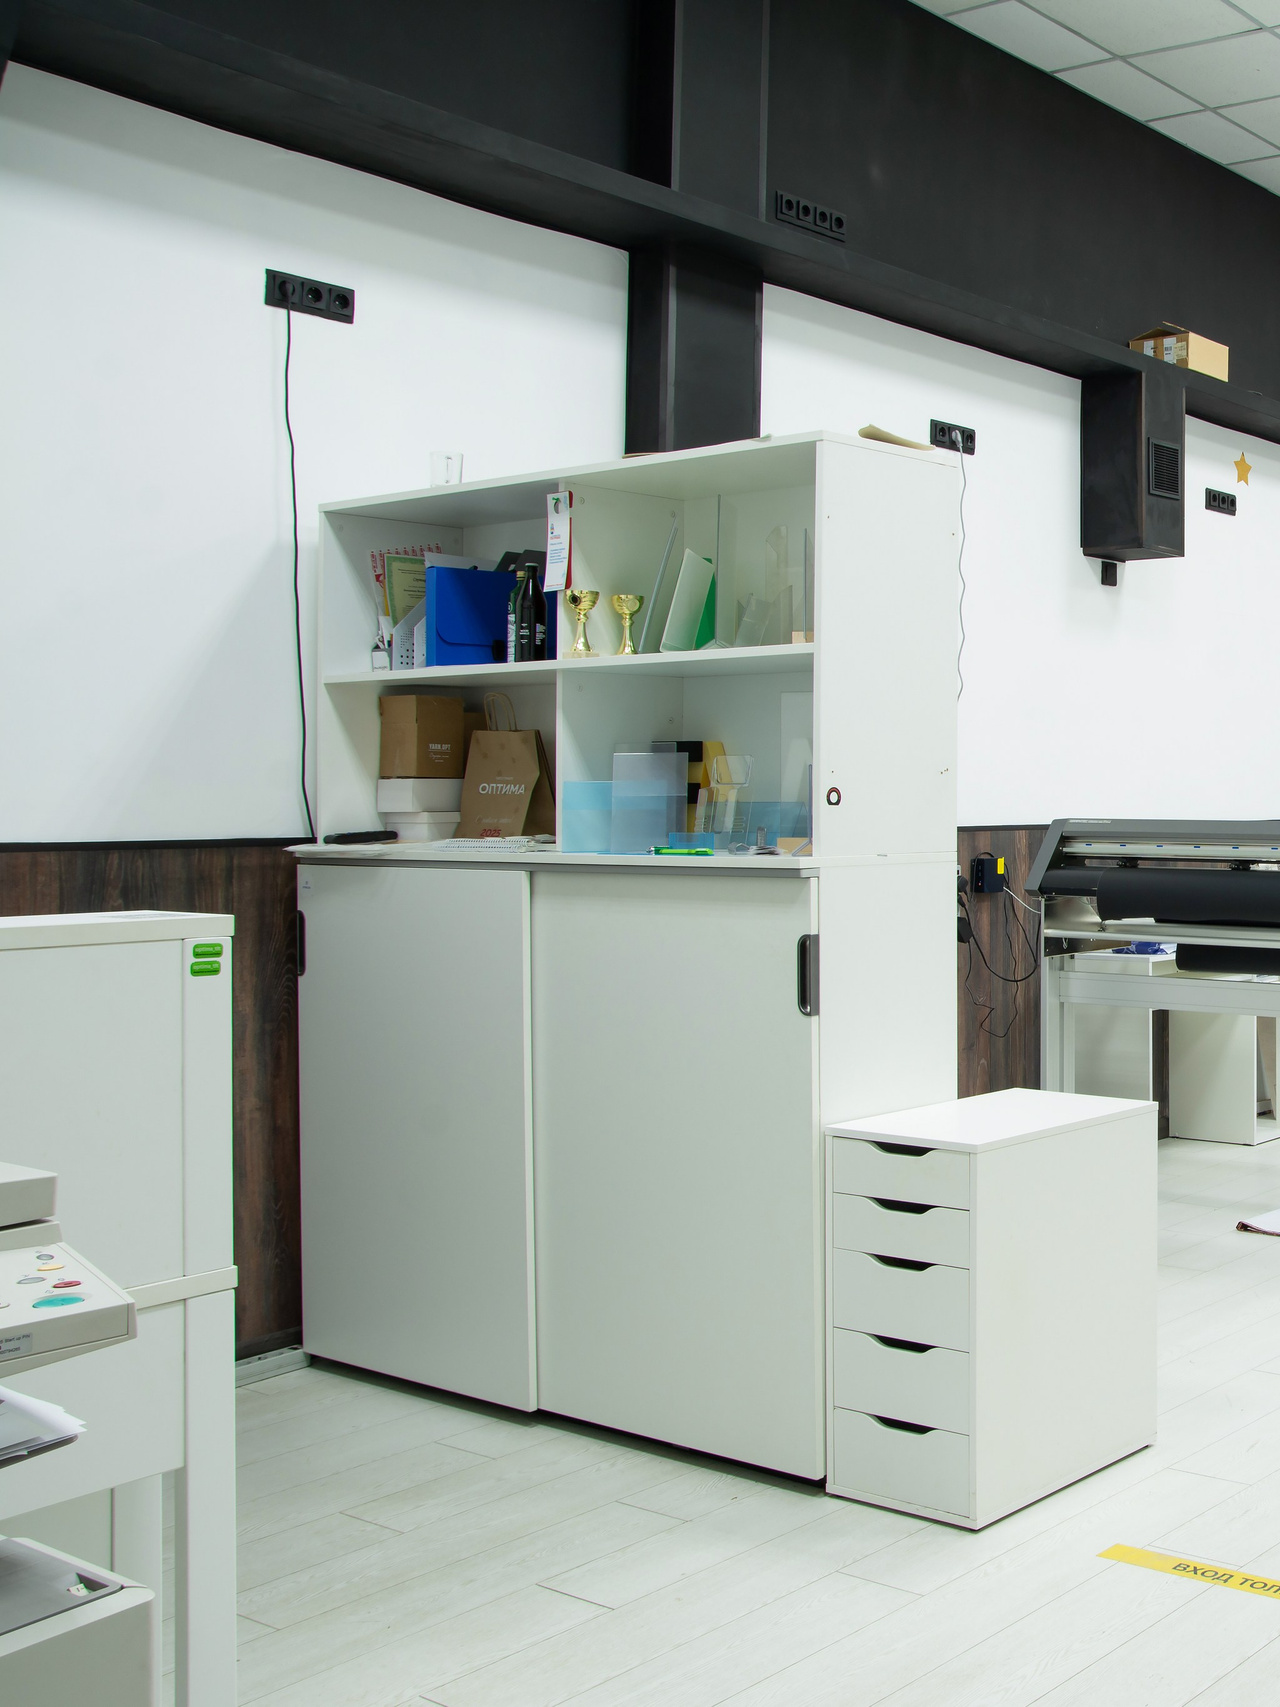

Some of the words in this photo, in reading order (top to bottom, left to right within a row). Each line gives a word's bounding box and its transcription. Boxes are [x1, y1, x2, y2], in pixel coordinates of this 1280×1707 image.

[479, 783, 525, 795] ОПТИМА
[480, 829, 502, 837] 2025
[1171, 1562, 1234, 1583] ВХОД
